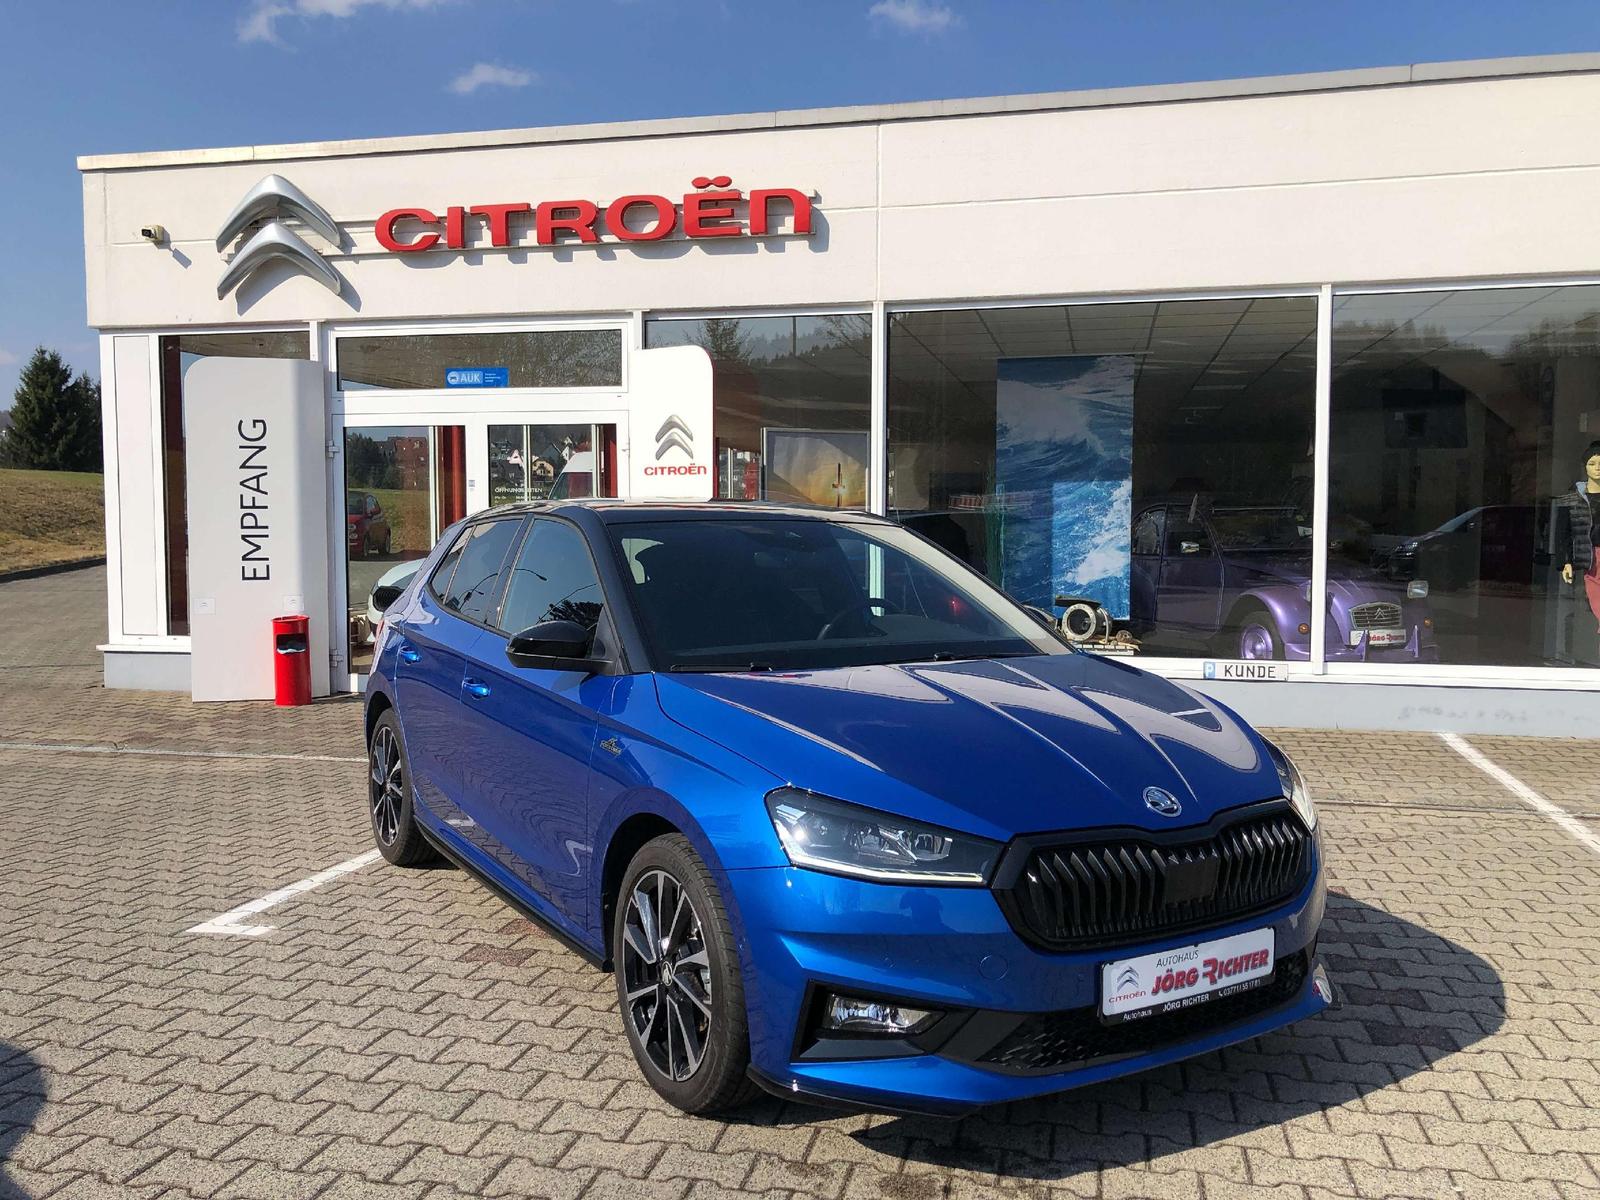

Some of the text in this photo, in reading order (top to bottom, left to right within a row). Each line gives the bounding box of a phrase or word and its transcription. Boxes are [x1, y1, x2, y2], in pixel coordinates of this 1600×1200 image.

[374, 176, 812, 252] CITROËN
[643, 462, 708, 477] CITROËN
[237, 419, 270, 581] EMPFANG
[1223, 664, 1276, 679] KUNDE
[1151, 949, 1269, 995] JÖRG RICHTER
[1156, 949, 1199, 968] AUTOHAUS
[1123, 1009, 1152, 1021] Autohaus
[1163, 1000, 1180, 1012] JÖRG
[1182, 993, 1210, 1007] RICHTER
